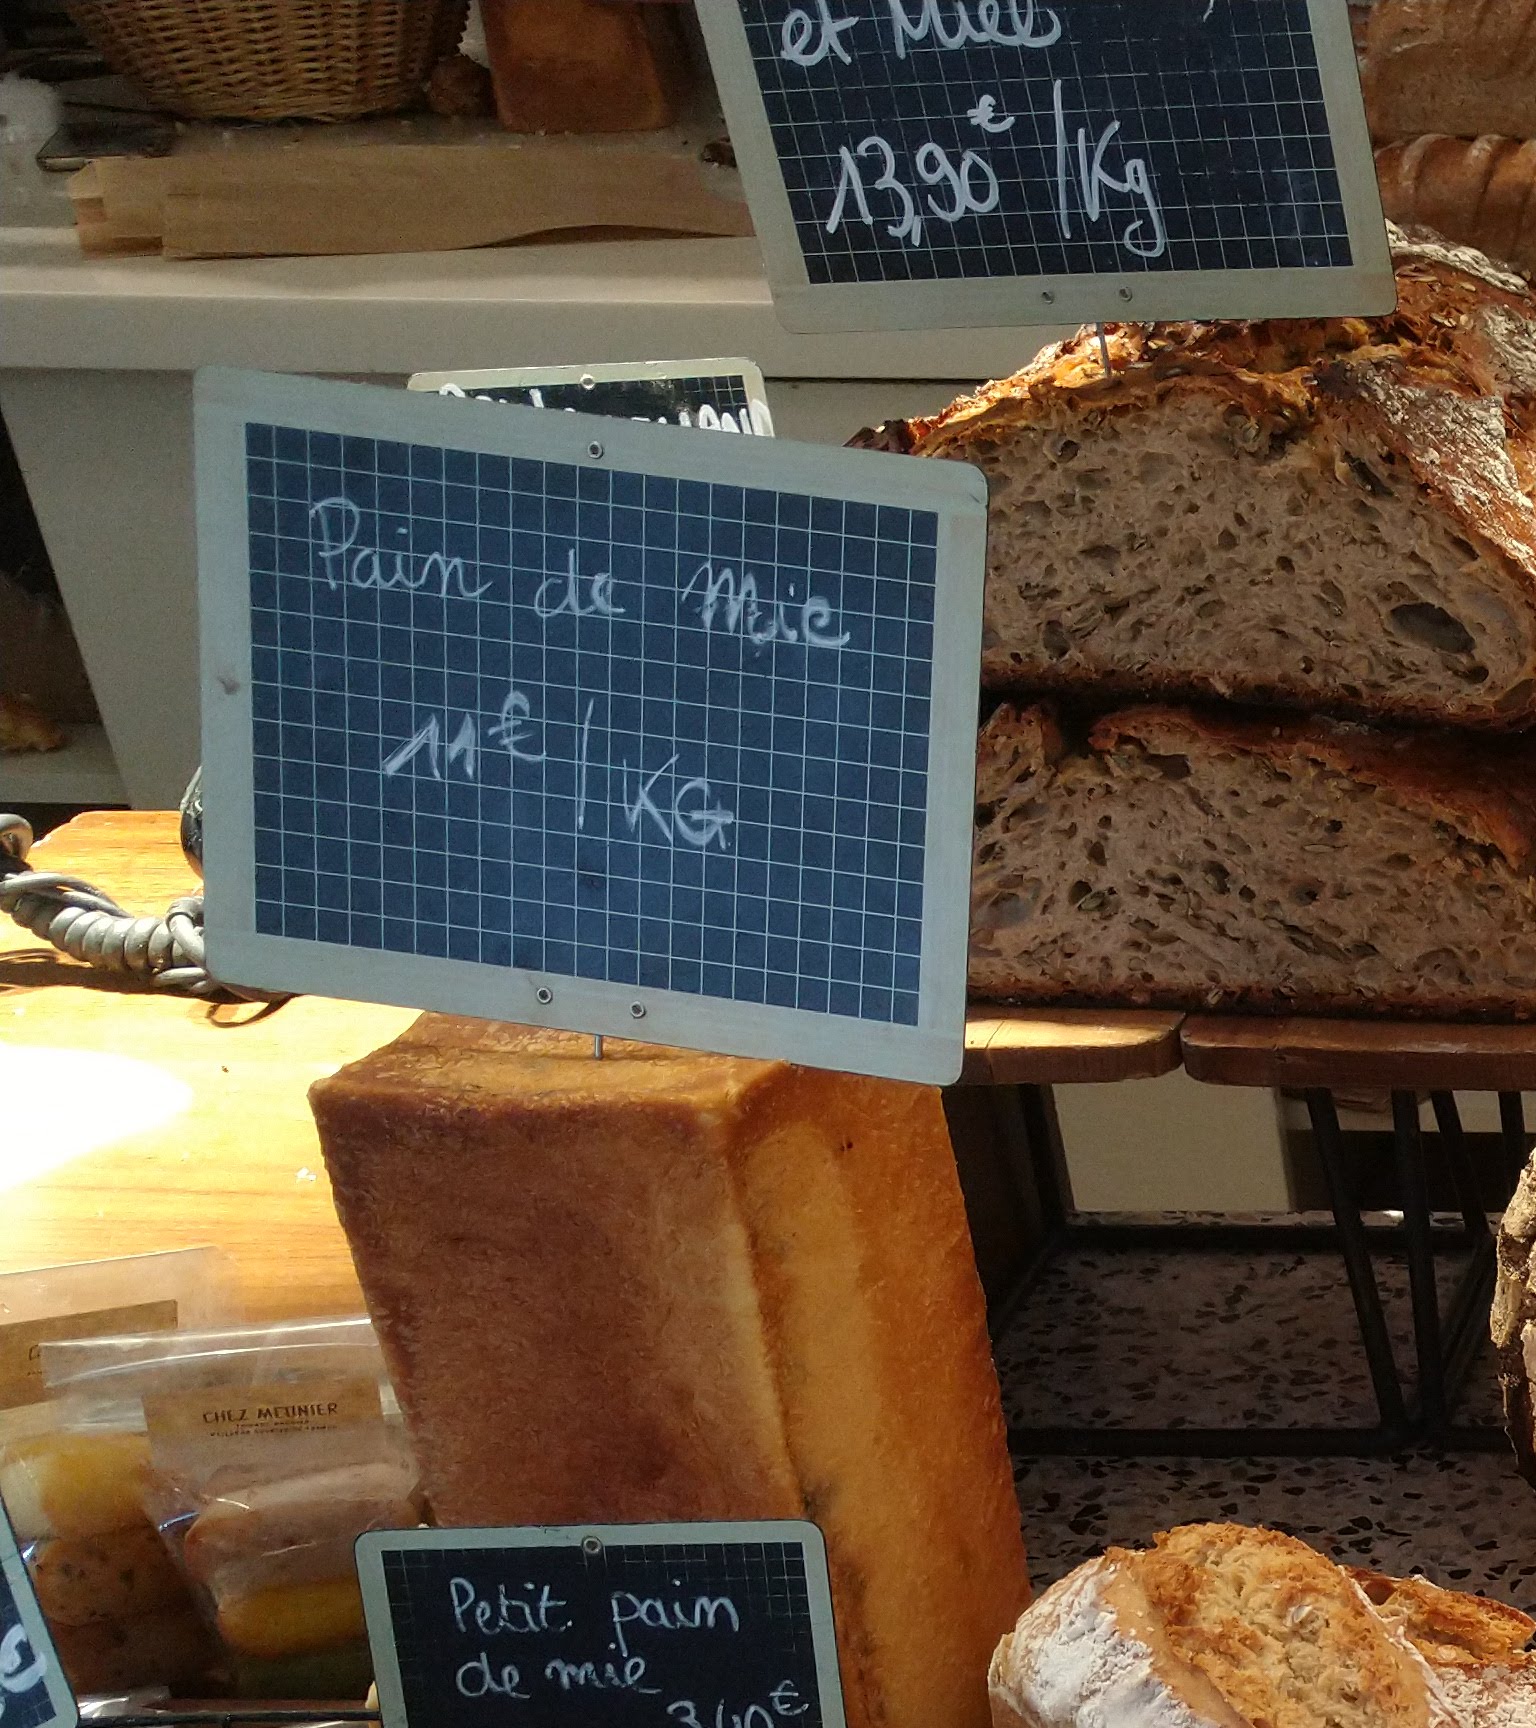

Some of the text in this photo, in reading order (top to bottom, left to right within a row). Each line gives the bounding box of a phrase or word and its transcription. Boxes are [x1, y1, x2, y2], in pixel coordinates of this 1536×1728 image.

[308, 497, 493, 598] Pain
[534, 548, 626, 618] de
[202, 1408, 250, 1425] CHEZ
[449, 1576, 741, 1657] Petit pain
[455, 1641, 663, 1699] de mie
